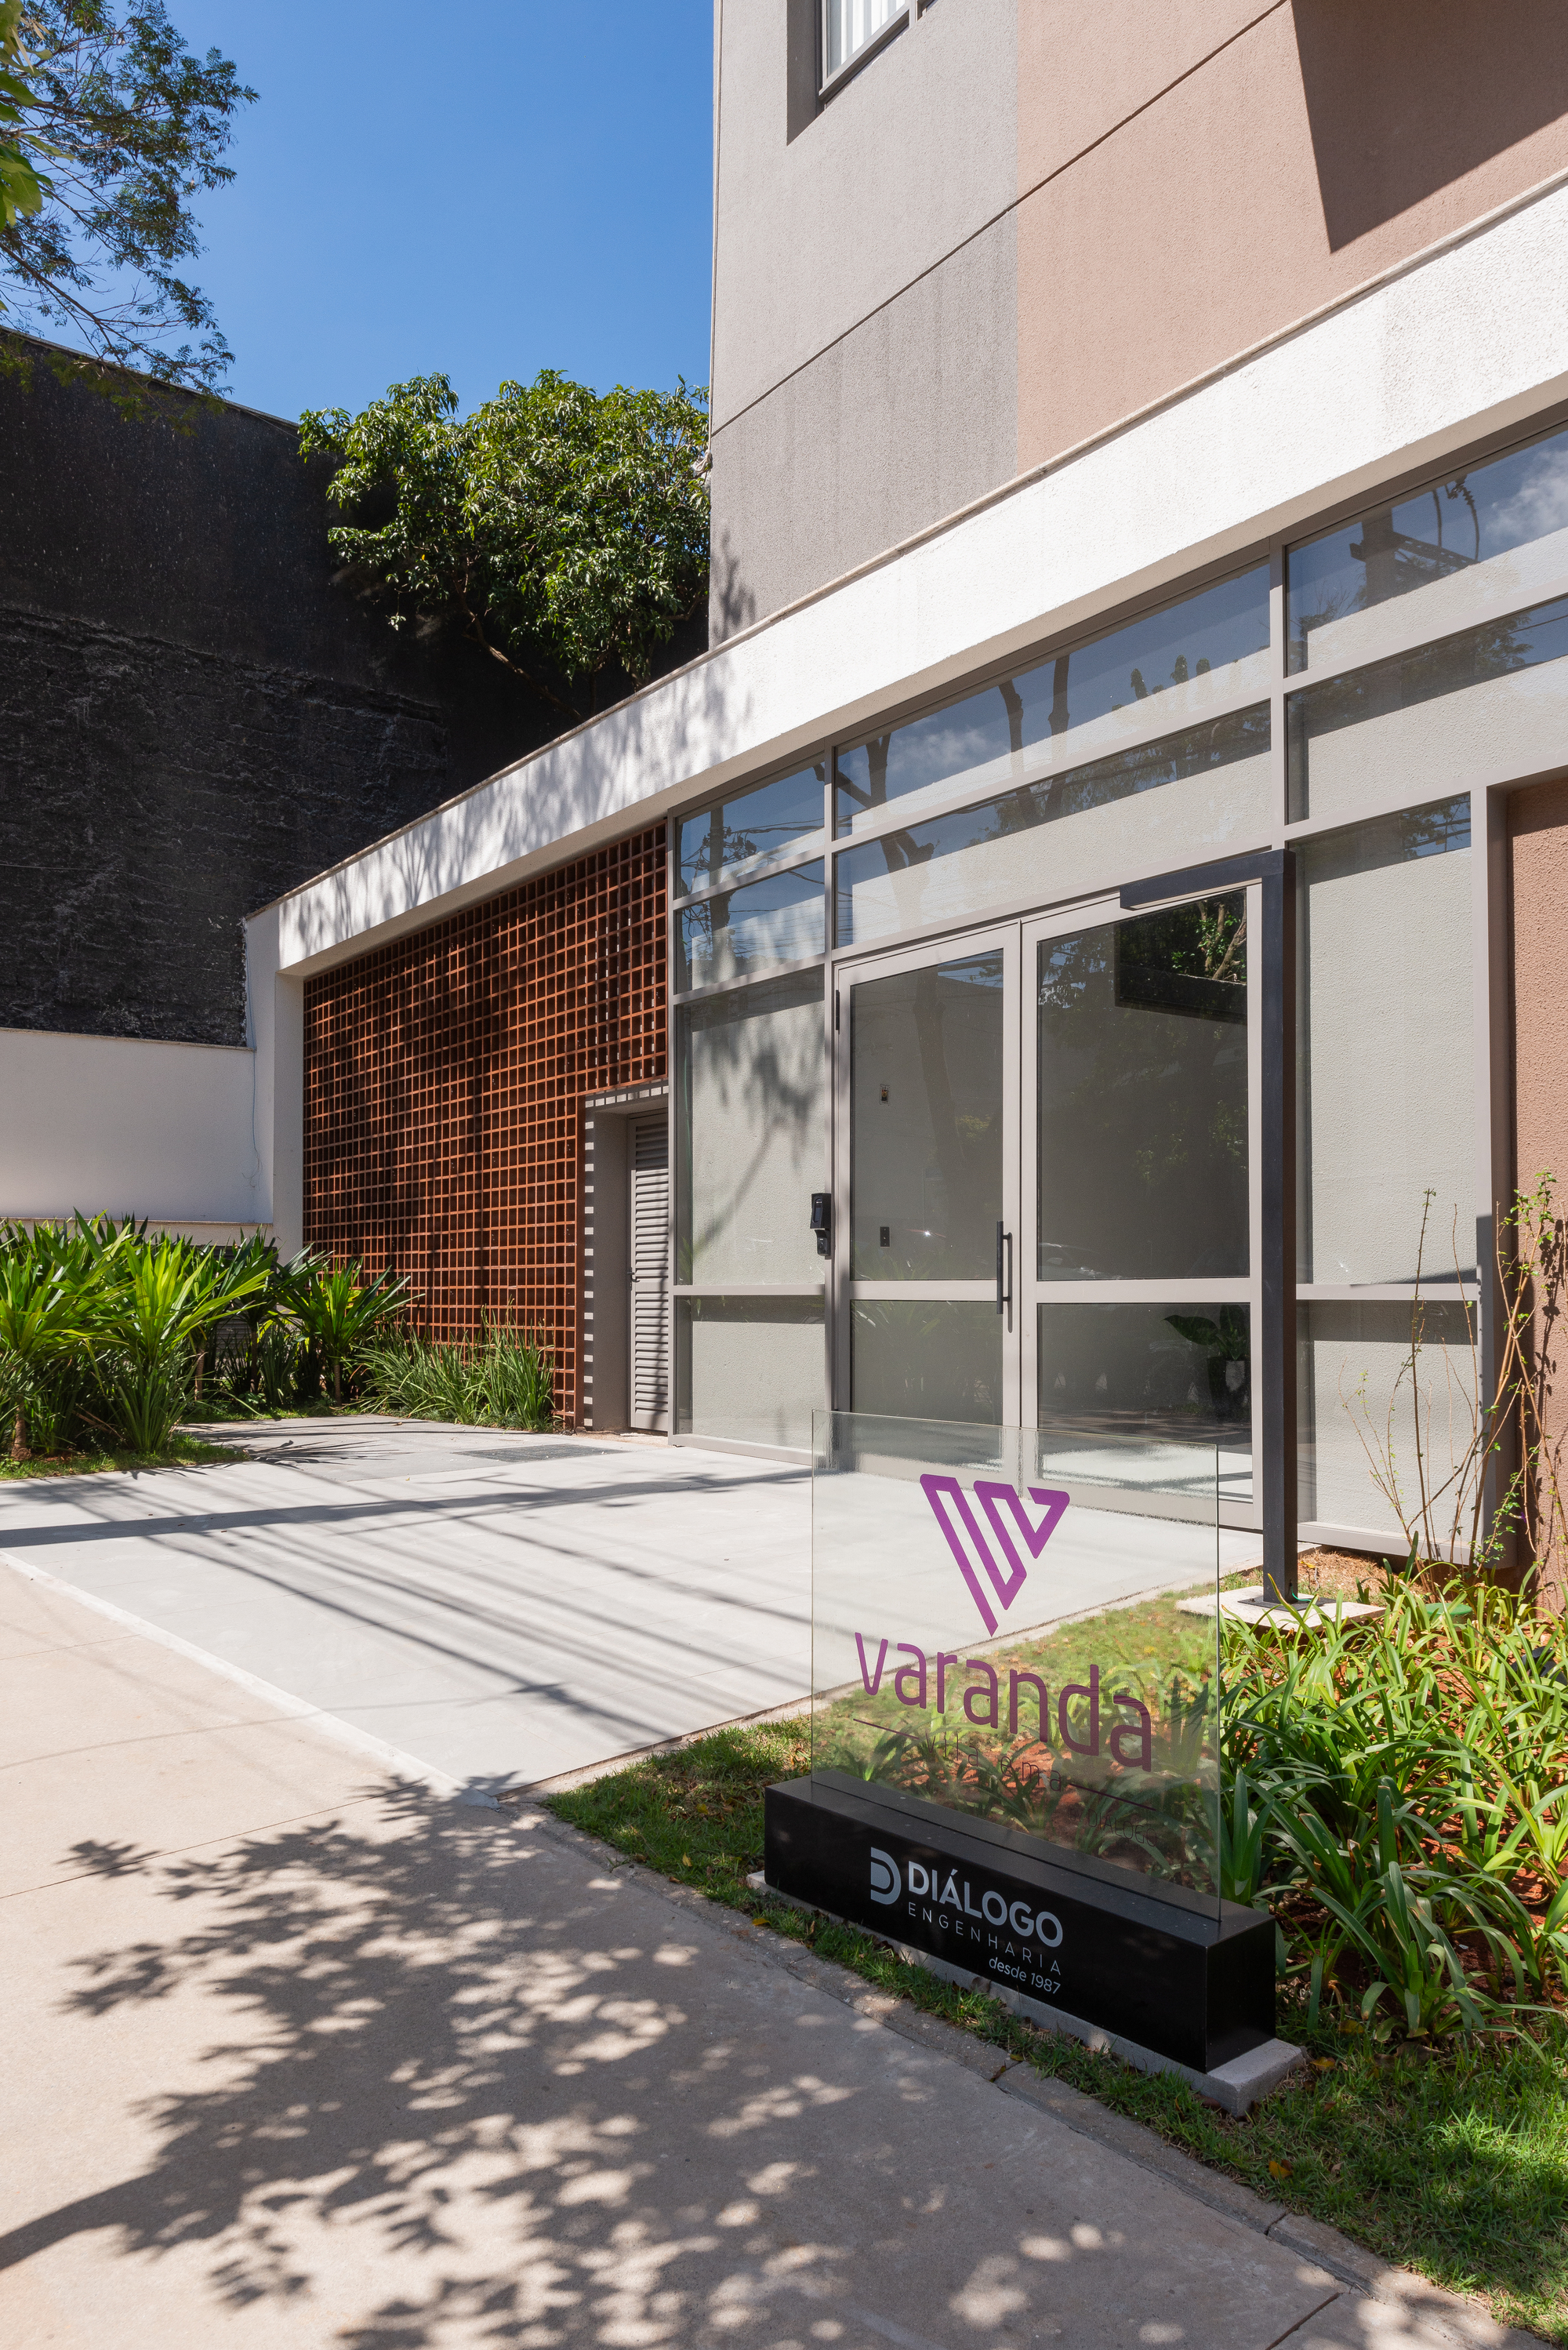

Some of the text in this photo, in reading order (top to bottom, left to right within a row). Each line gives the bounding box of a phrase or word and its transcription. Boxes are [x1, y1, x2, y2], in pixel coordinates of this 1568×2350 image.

[855, 1632, 1152, 1772] varanda
[925, 1728, 1062, 1792] vila ema
[908, 1861, 1063, 1948] DIÁLOGO
[908, 1901, 1062, 1975] ENGENHARIA
[989, 1956, 1062, 1994] desde 1987
